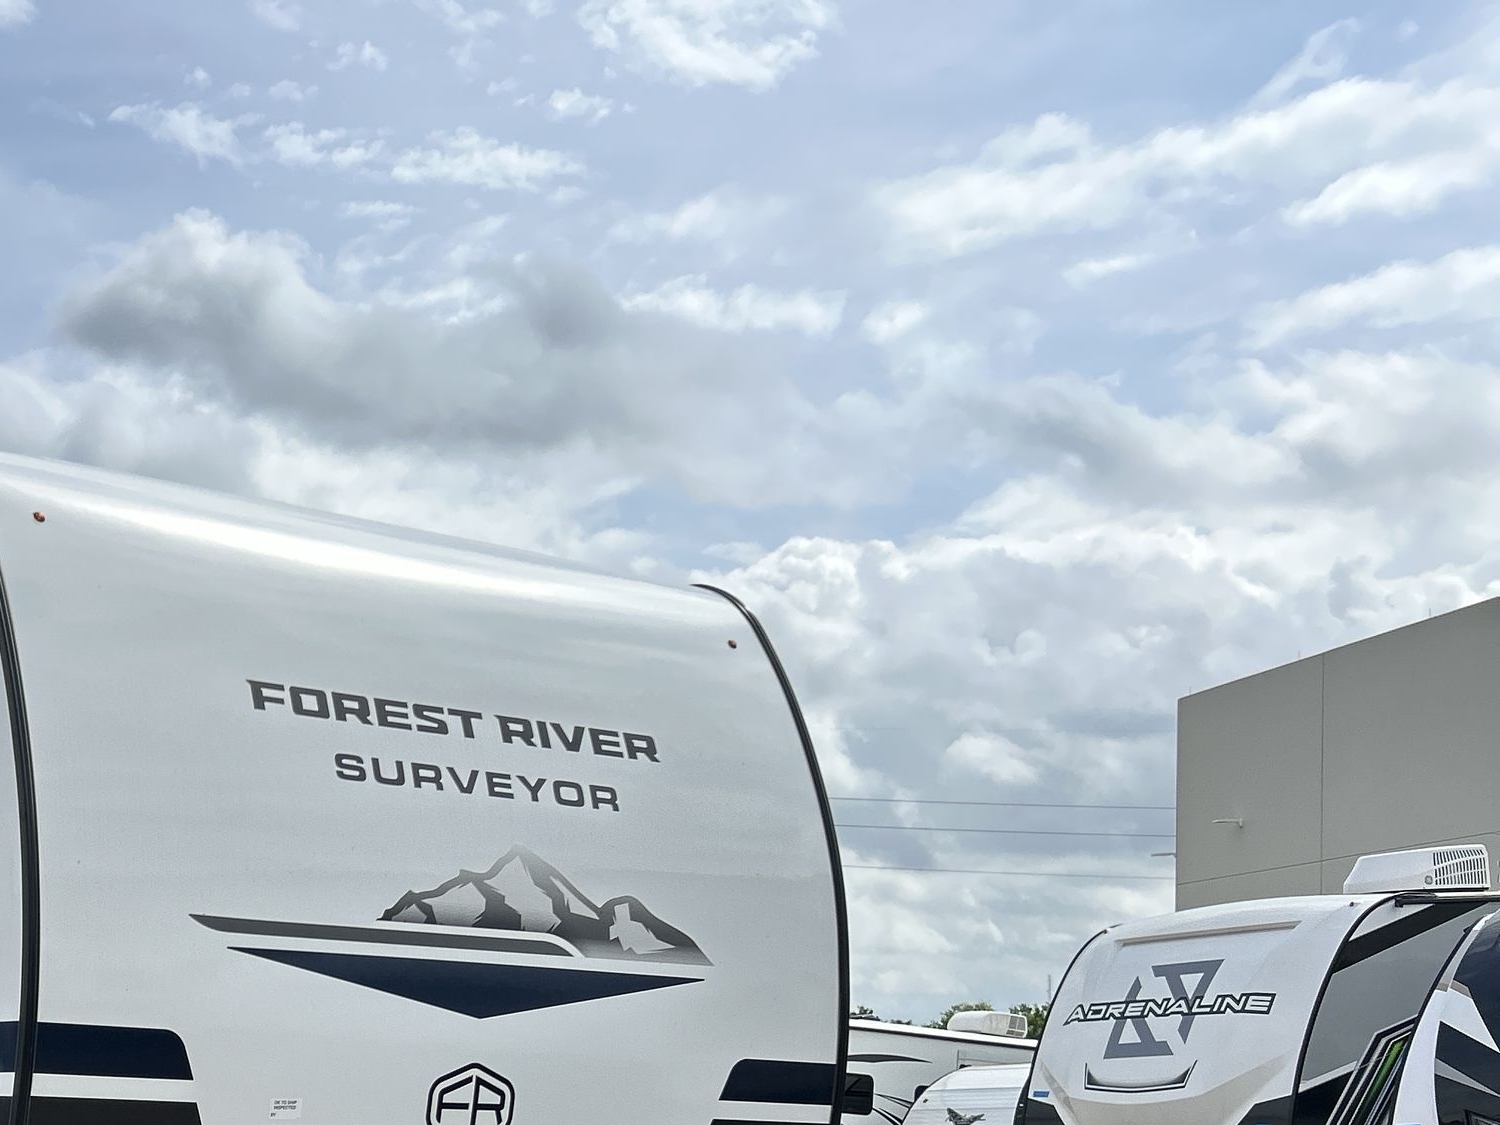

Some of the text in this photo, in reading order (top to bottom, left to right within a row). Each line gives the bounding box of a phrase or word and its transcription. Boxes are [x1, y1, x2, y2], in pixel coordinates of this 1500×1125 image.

[245, 679, 661, 763] FOREST RIVER
[334, 752, 620, 812] SURVEYOR
[1062, 992, 1277, 1026] ADRENALINE
